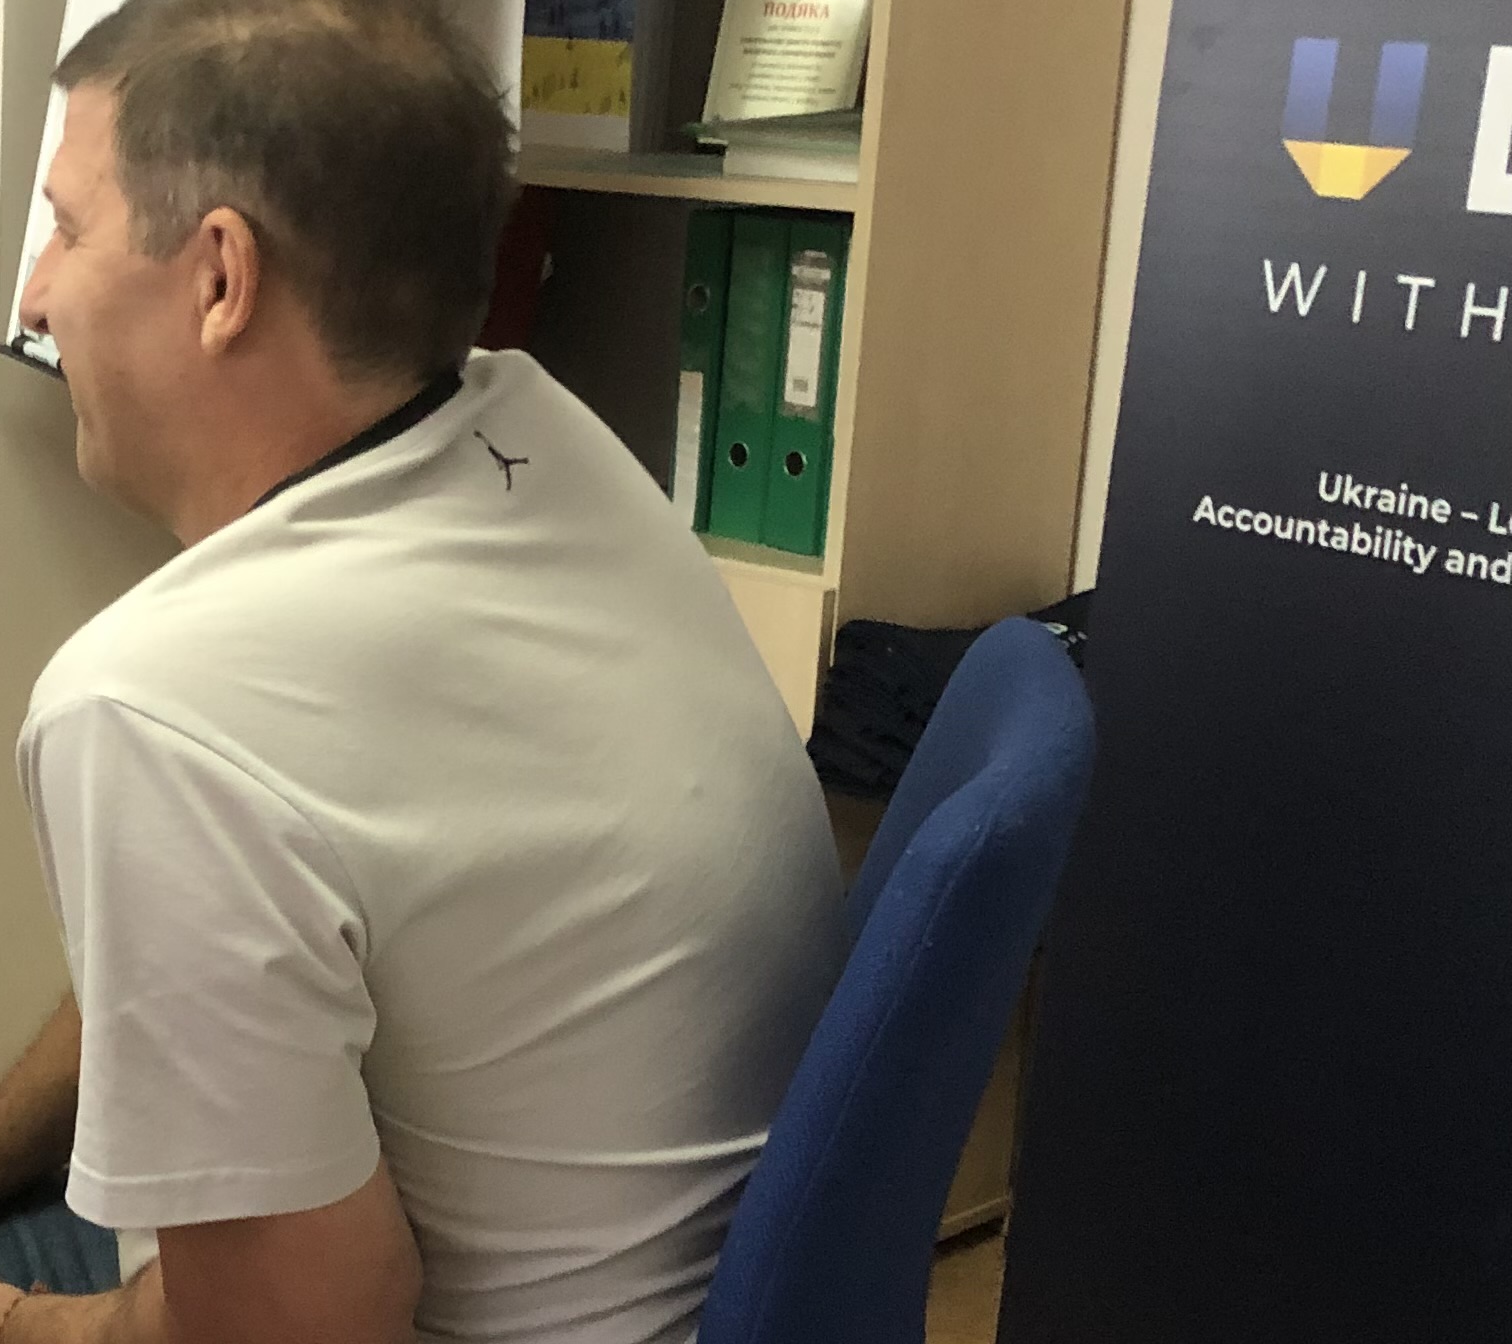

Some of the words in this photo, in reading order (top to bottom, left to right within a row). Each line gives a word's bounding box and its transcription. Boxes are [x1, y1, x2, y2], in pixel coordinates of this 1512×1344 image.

[764, 1, 830, 19] ПОДЯКА
[1264, 258, 1510, 342] WITH
[1318, 471, 1452, 524] Ukraine
[1193, 495, 1438, 574] Accountability
[1444, 547, 1512, 585] and
